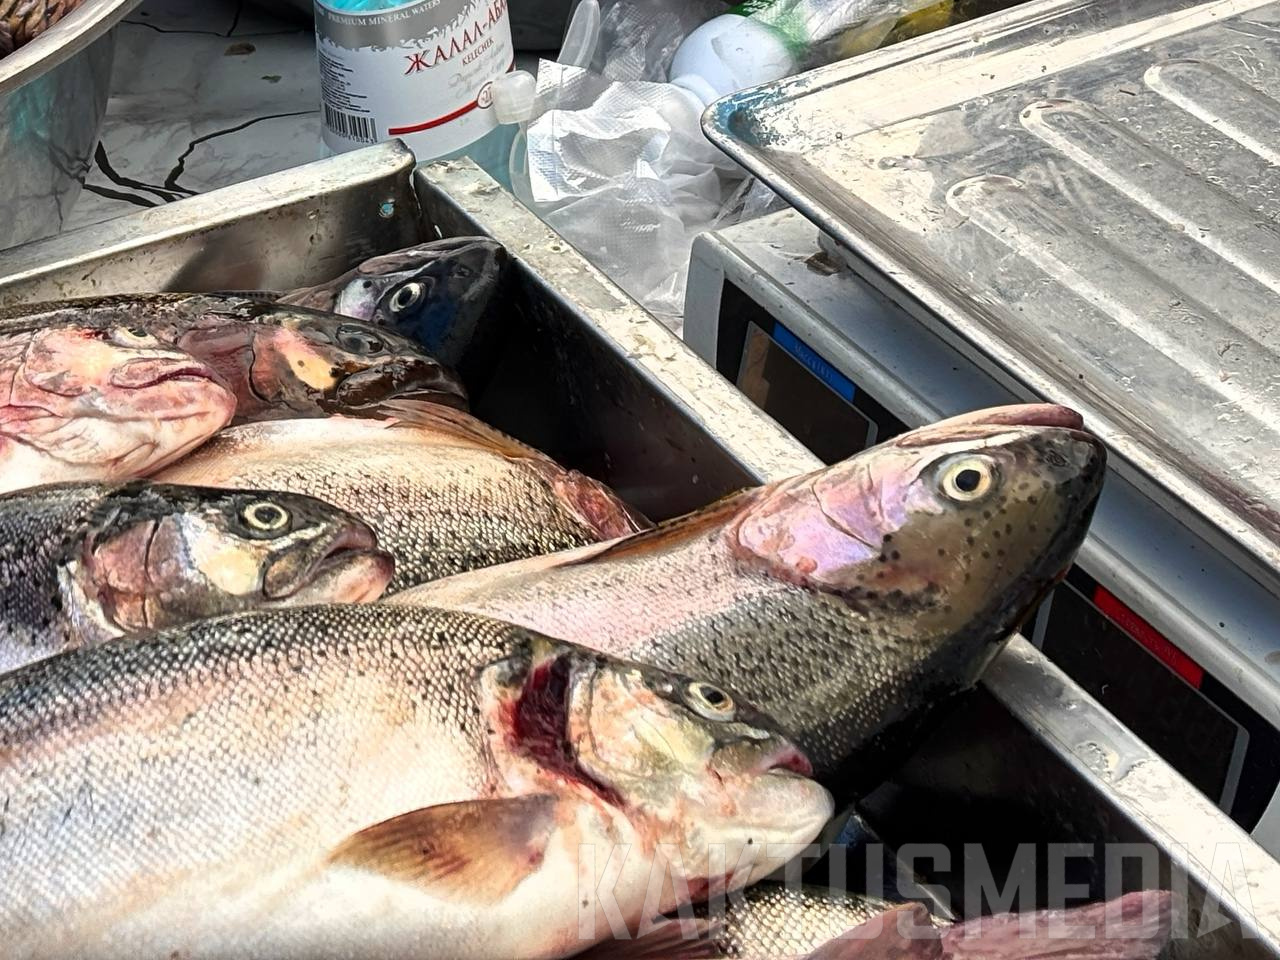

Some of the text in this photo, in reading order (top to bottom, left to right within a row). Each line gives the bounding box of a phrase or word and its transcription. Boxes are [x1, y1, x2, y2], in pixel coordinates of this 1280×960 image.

[328, 11, 368, 27] PREMIUM
[368, 10, 411, 25] MINERAL
[461, 37, 495, 67] KELECHEK
